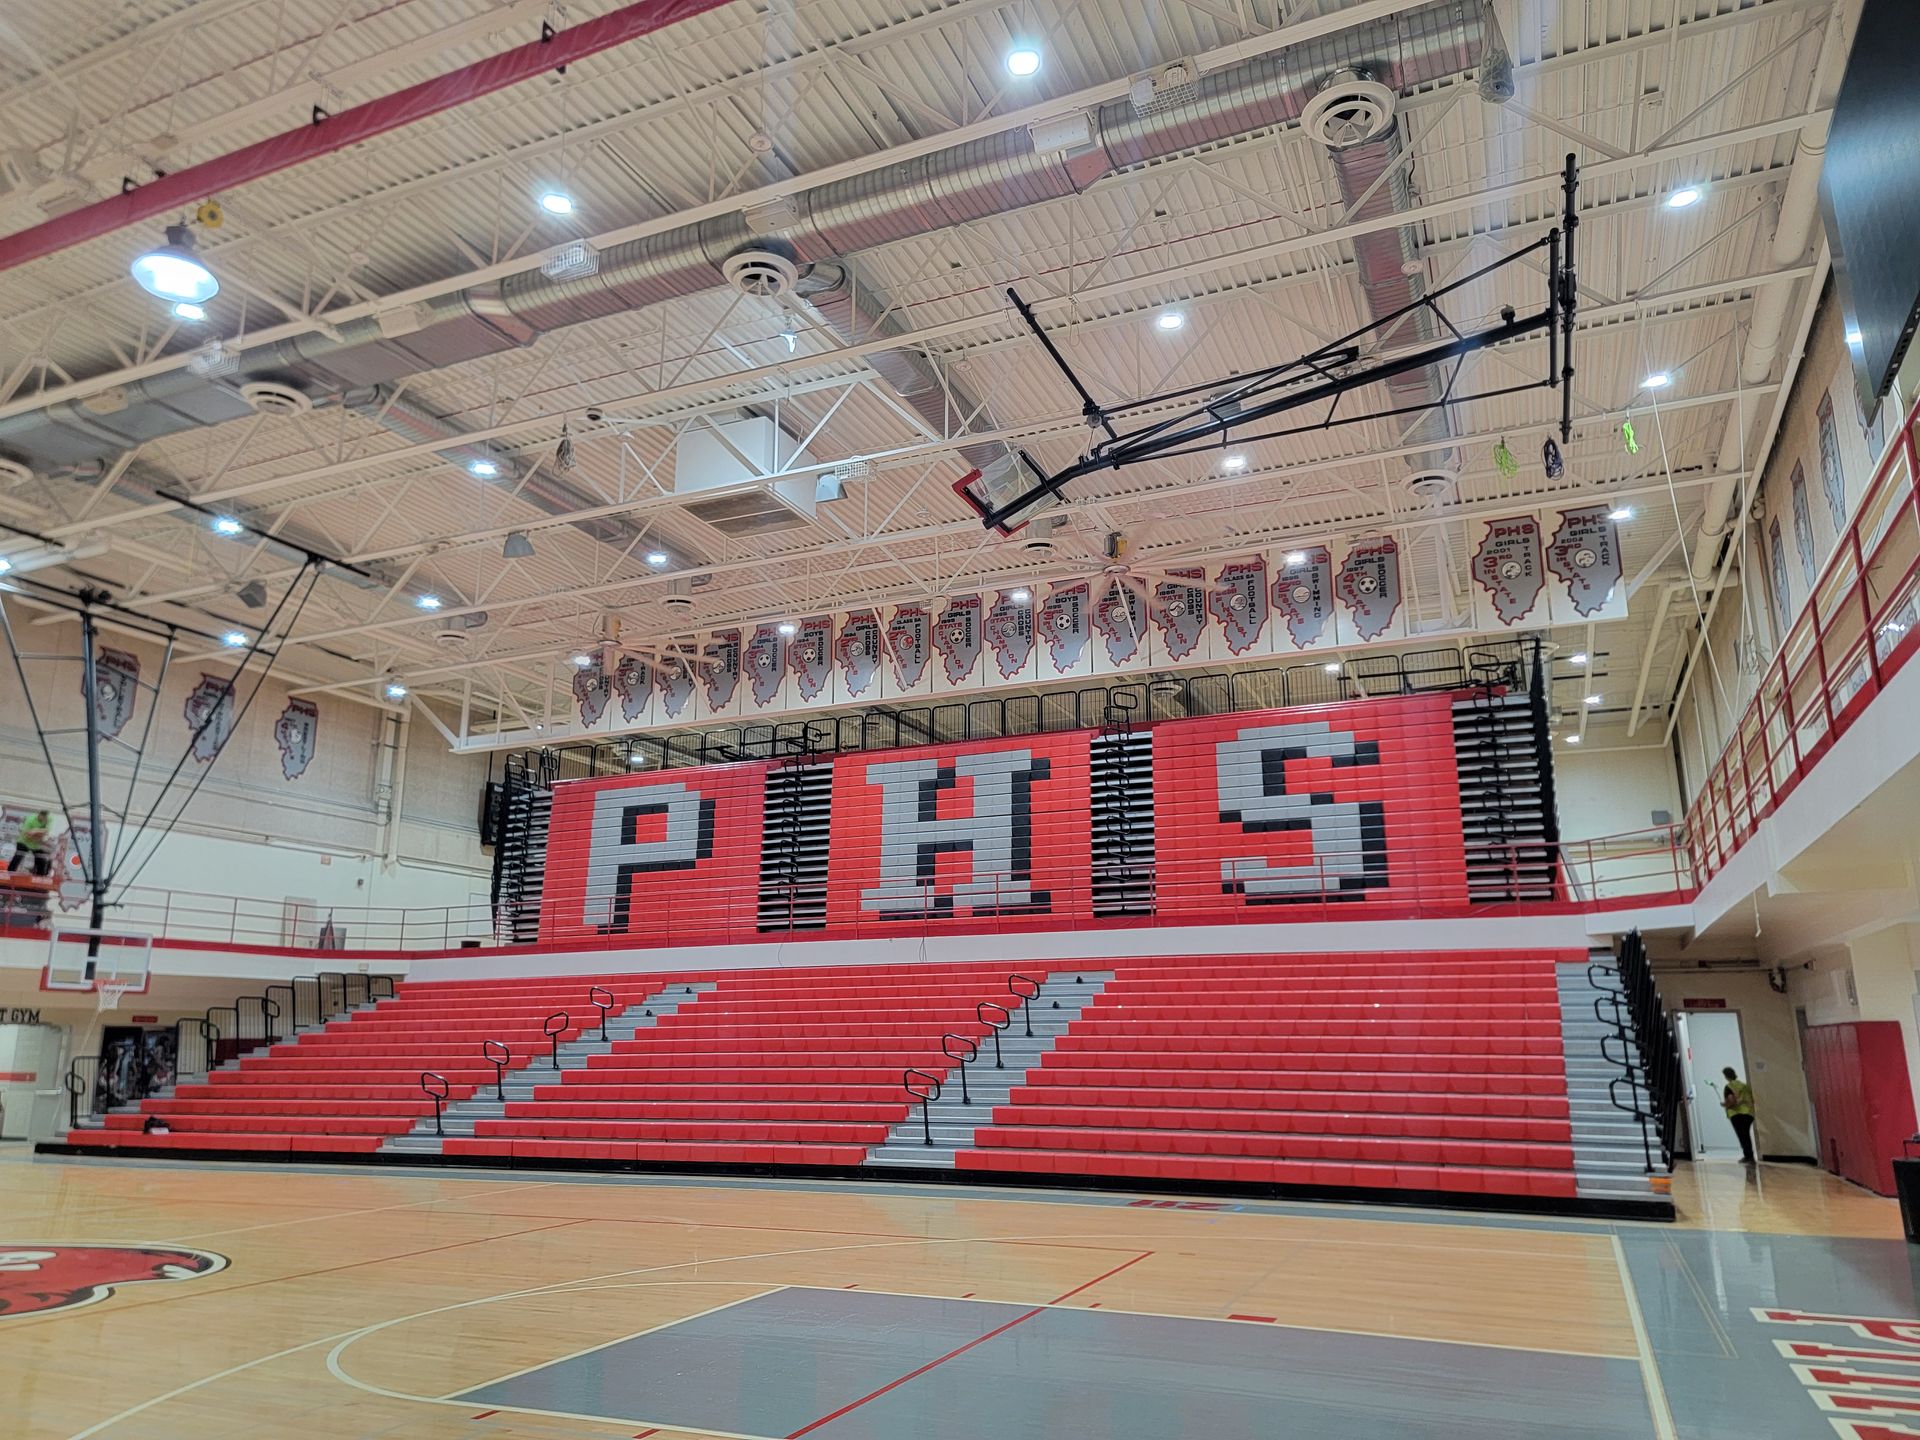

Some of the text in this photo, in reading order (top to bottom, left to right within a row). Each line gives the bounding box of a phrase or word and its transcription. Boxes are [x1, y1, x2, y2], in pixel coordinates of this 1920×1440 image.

[1494, 523, 1535, 539] PHS
[1495, 537, 1530, 548] GIRLS
[1570, 526, 1607, 537] GIRLS
[1483, 554, 1513, 569] 3RD
[1523, 545, 1532, 577] TRACK
[1599, 535, 1610, 566] TRACK
[1228, 563, 1263, 575] PHS
[1378, 563, 1388, 599] SOCCER
[1563, 561, 1591, 590] STATE
[1248, 580, 1256, 624] FOOTBALL
[1312, 572, 1321, 618] SWIMMING
[1347, 589, 1370, 616] STATE
[1491, 574, 1516, 604] STATE
[951, 599, 978, 611] PHS
[1216, 597, 1247, 637] FINALIST
[1282, 597, 1304, 624] STATE
[804, 620, 830, 631] PHS
[1046, 626, 1064, 649] STATE
[1102, 618, 1121, 642] STATE
[939, 631, 963, 669] CHAMPION
[990, 626, 1017, 663] CHAMPION
[794, 651, 816, 688] CHAMPION
[11, 1008, 41, 1024] GYM
